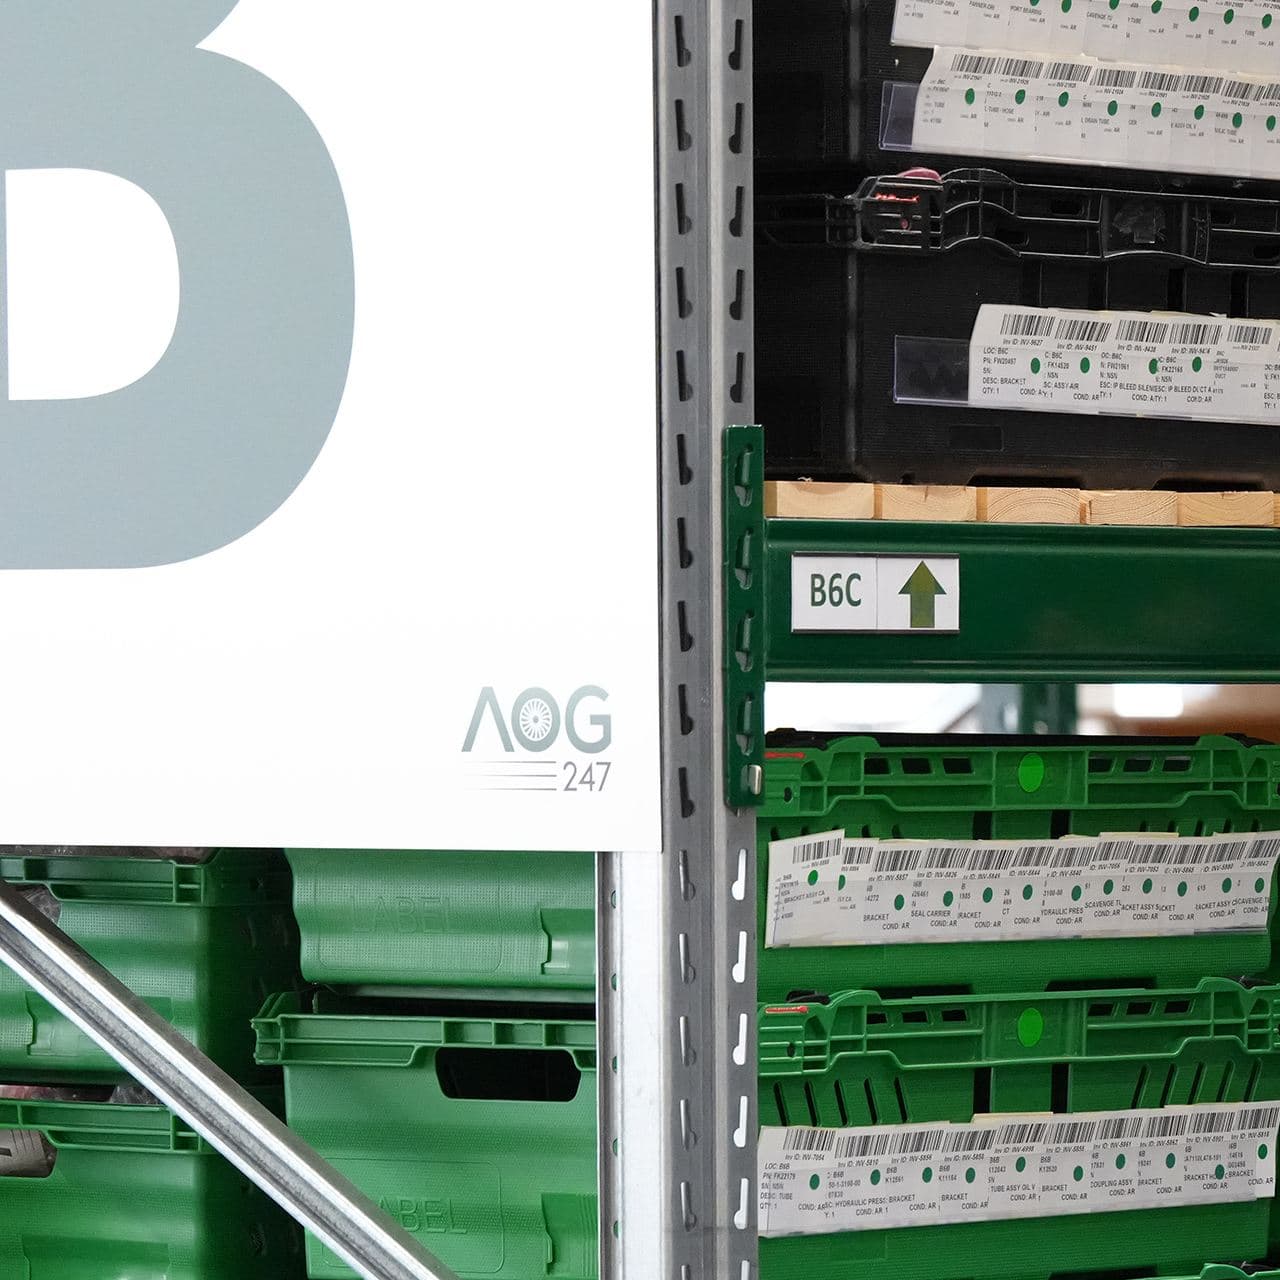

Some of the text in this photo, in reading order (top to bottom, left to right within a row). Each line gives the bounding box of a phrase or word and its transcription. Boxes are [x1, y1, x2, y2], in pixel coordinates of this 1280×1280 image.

[811, 573, 861, 607] B6C
[461, 685, 611, 754] AOG
[563, 761, 611, 791] 247
[351, 896, 465, 934] LABEL
[927, 910, 951, 918] CARRIER
[1169, 913, 1186, 921] COND:
[1014, 917, 1031, 925] COND:
[1115, 1179, 1133, 1187] ASSY
[1248, 1178, 1265, 1186] COND:
[889, 1194, 915, 1203] BRACKET
[941, 1193, 968, 1201] BRACKET
[856, 1207, 883, 1216] COND: AR
